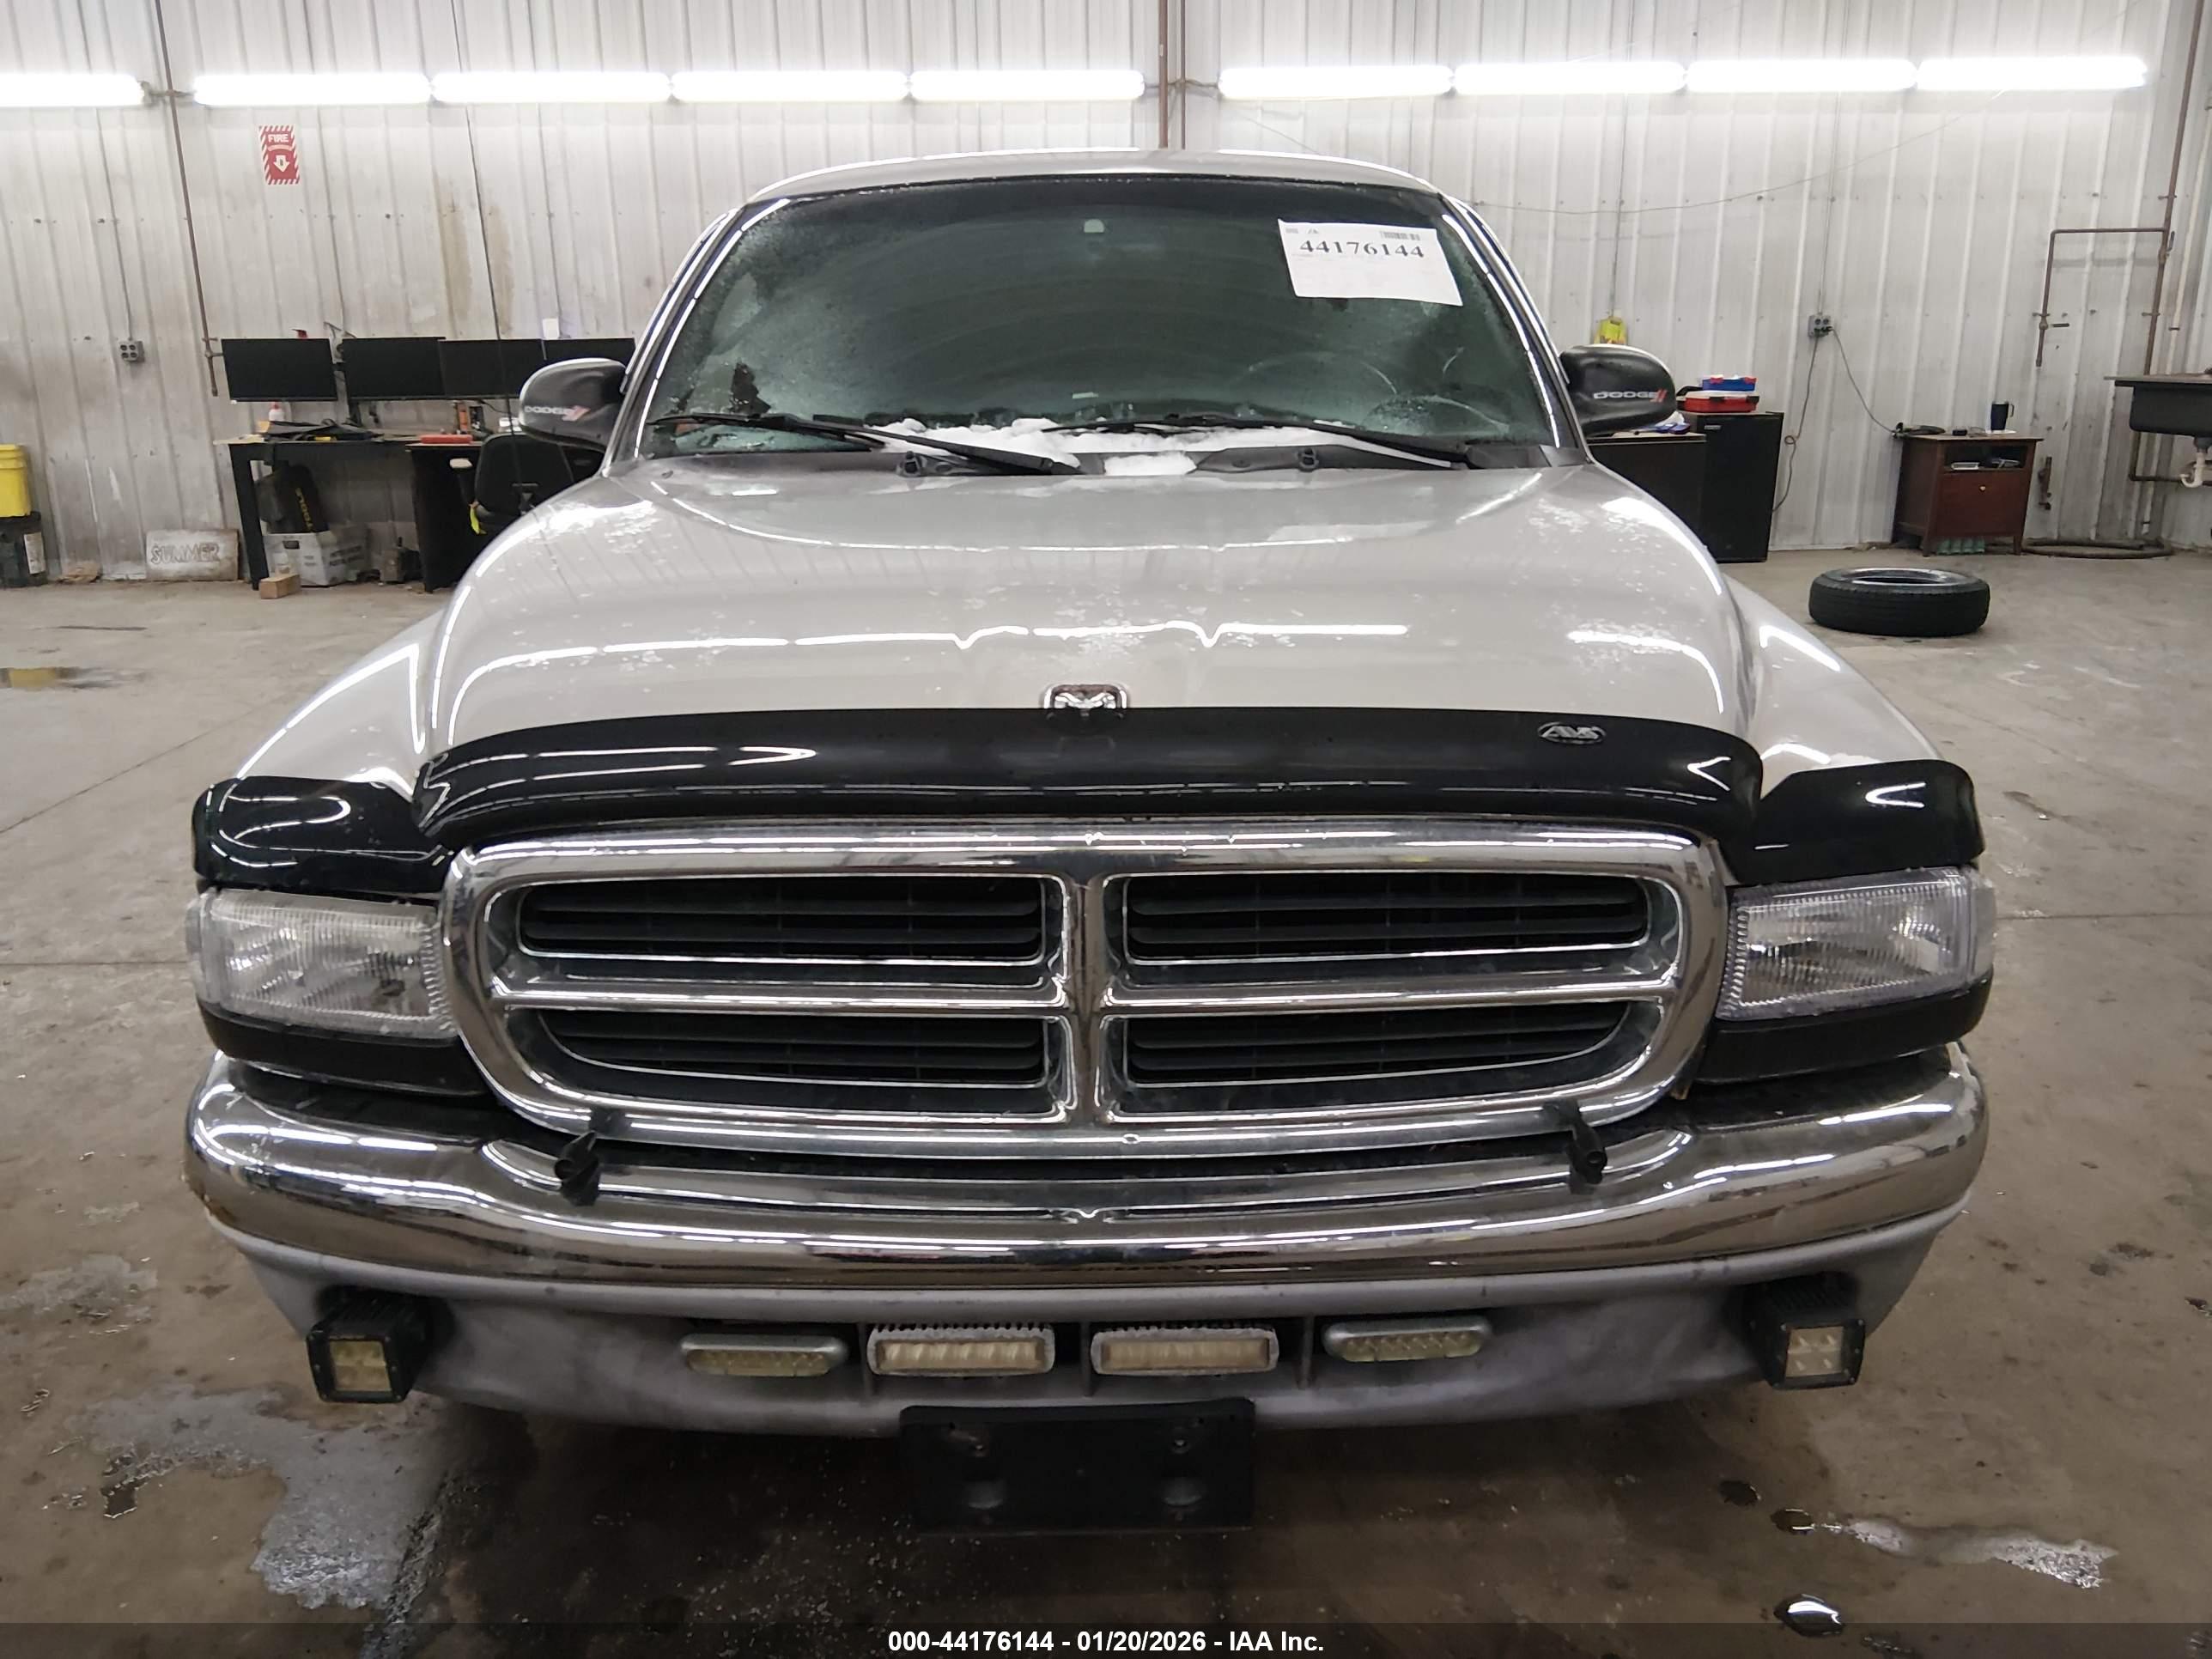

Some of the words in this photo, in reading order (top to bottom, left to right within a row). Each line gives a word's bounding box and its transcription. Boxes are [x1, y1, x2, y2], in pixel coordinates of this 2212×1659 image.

[267, 133, 289, 143] FIRE
[1299, 240, 1425, 258] 44176144
[1593, 391, 1657, 399] DODGE
[150, 543, 220, 565] SUMMER
